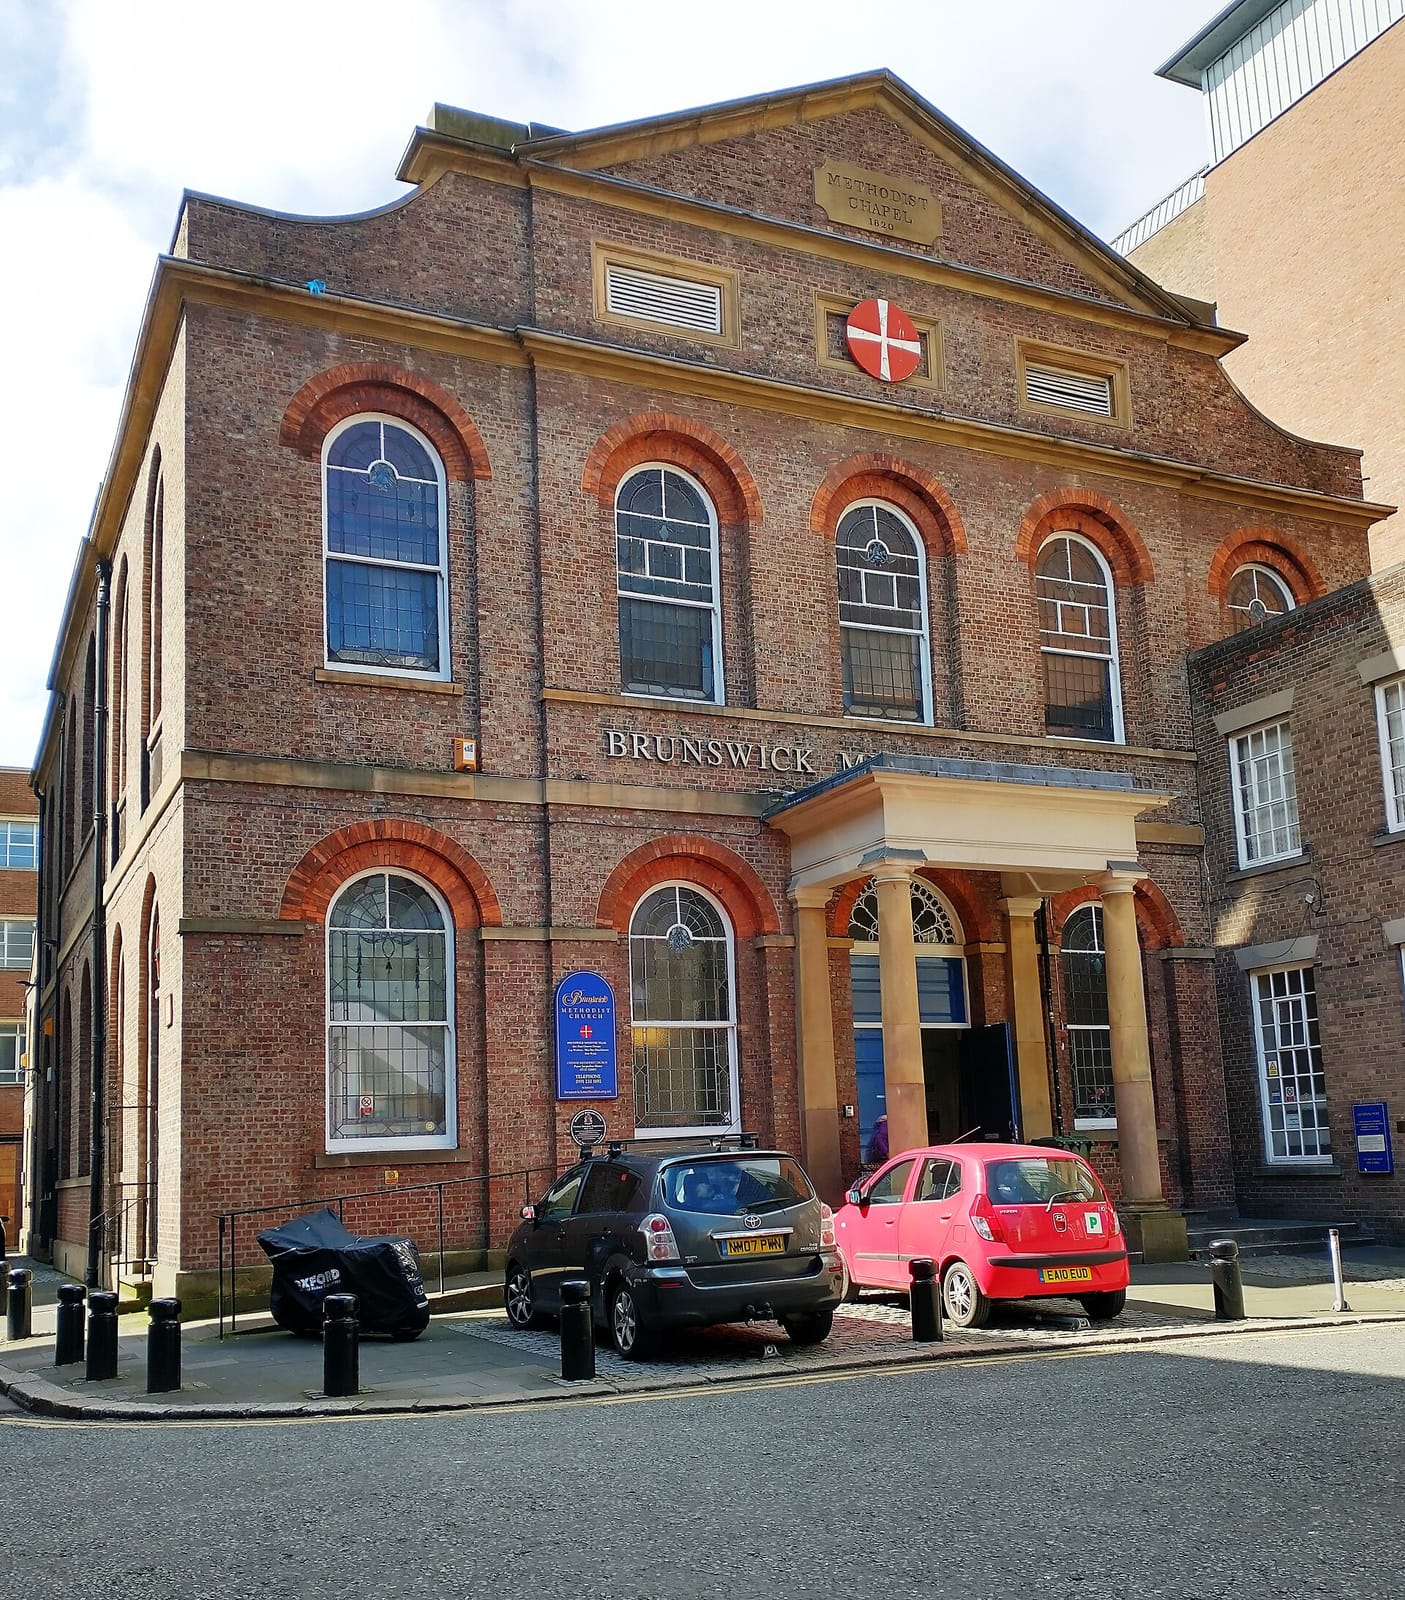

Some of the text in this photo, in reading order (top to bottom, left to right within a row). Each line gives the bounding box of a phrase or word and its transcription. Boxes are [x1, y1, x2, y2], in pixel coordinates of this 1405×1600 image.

[827, 172, 928, 210] METHODIST
[848, 197, 913, 224] CHAPEL
[869, 218, 894, 231] 1820
[606, 731, 816, 773] BRUNSWICK
[1089, 1216, 1098, 1229] P
[729, 1240, 757, 1253] NM07
[1047, 1268, 1089, 1281] EA10 EUD
